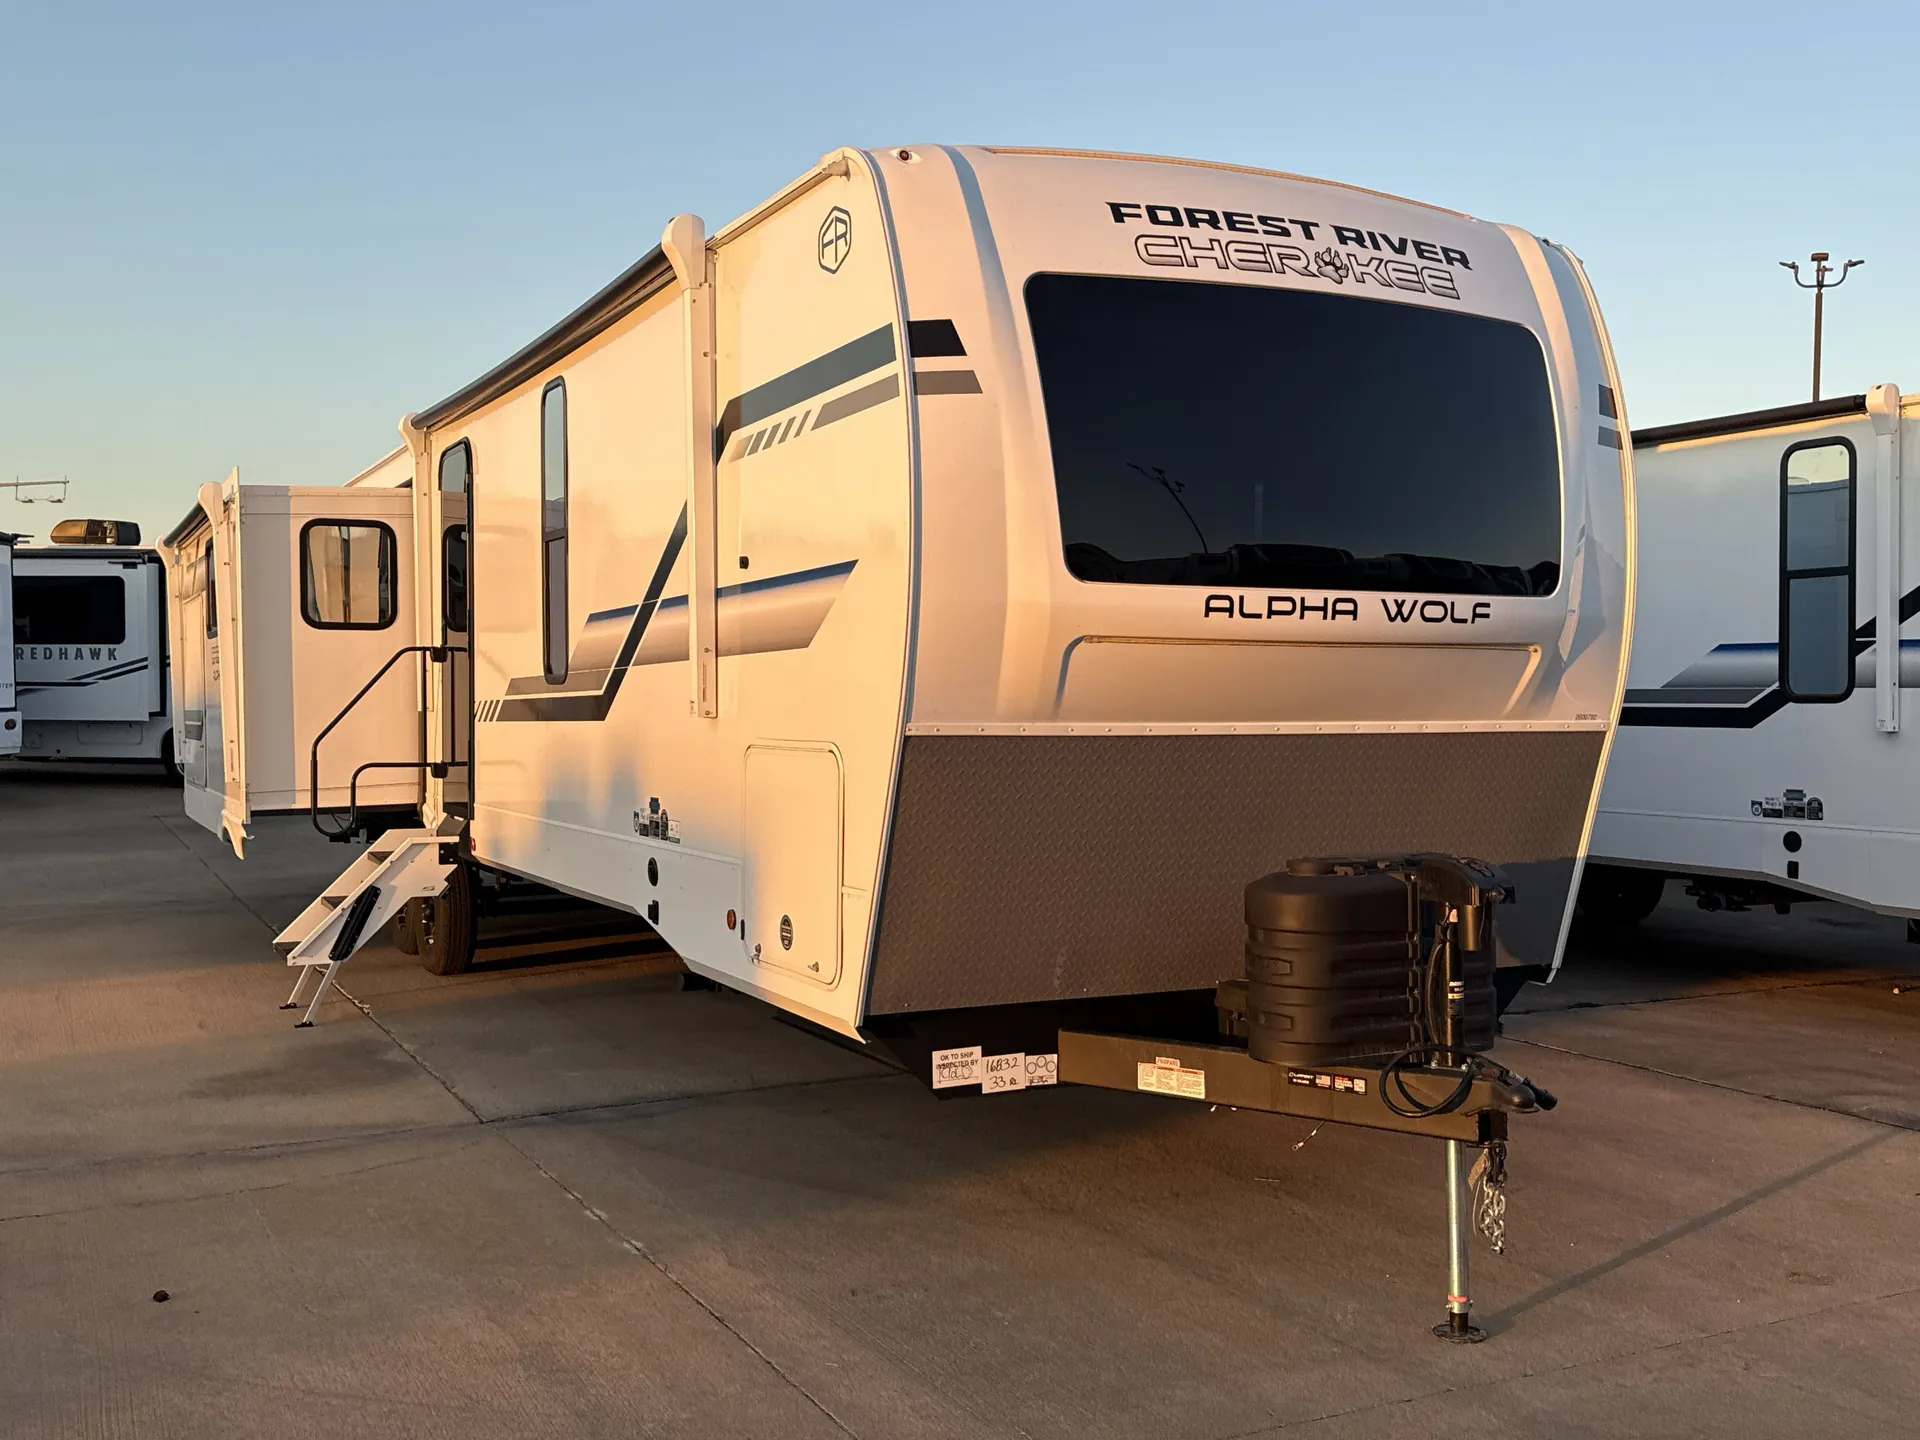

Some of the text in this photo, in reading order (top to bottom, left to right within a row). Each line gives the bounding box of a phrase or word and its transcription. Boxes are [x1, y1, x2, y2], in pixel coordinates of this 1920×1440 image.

[1105, 201, 1473, 271] FOREST RIVER
[1204, 594, 1491, 624] ALPHA WOLF
[15, 647, 118, 661] REDHAWK
[960, 1051, 974, 1059] SHIP
